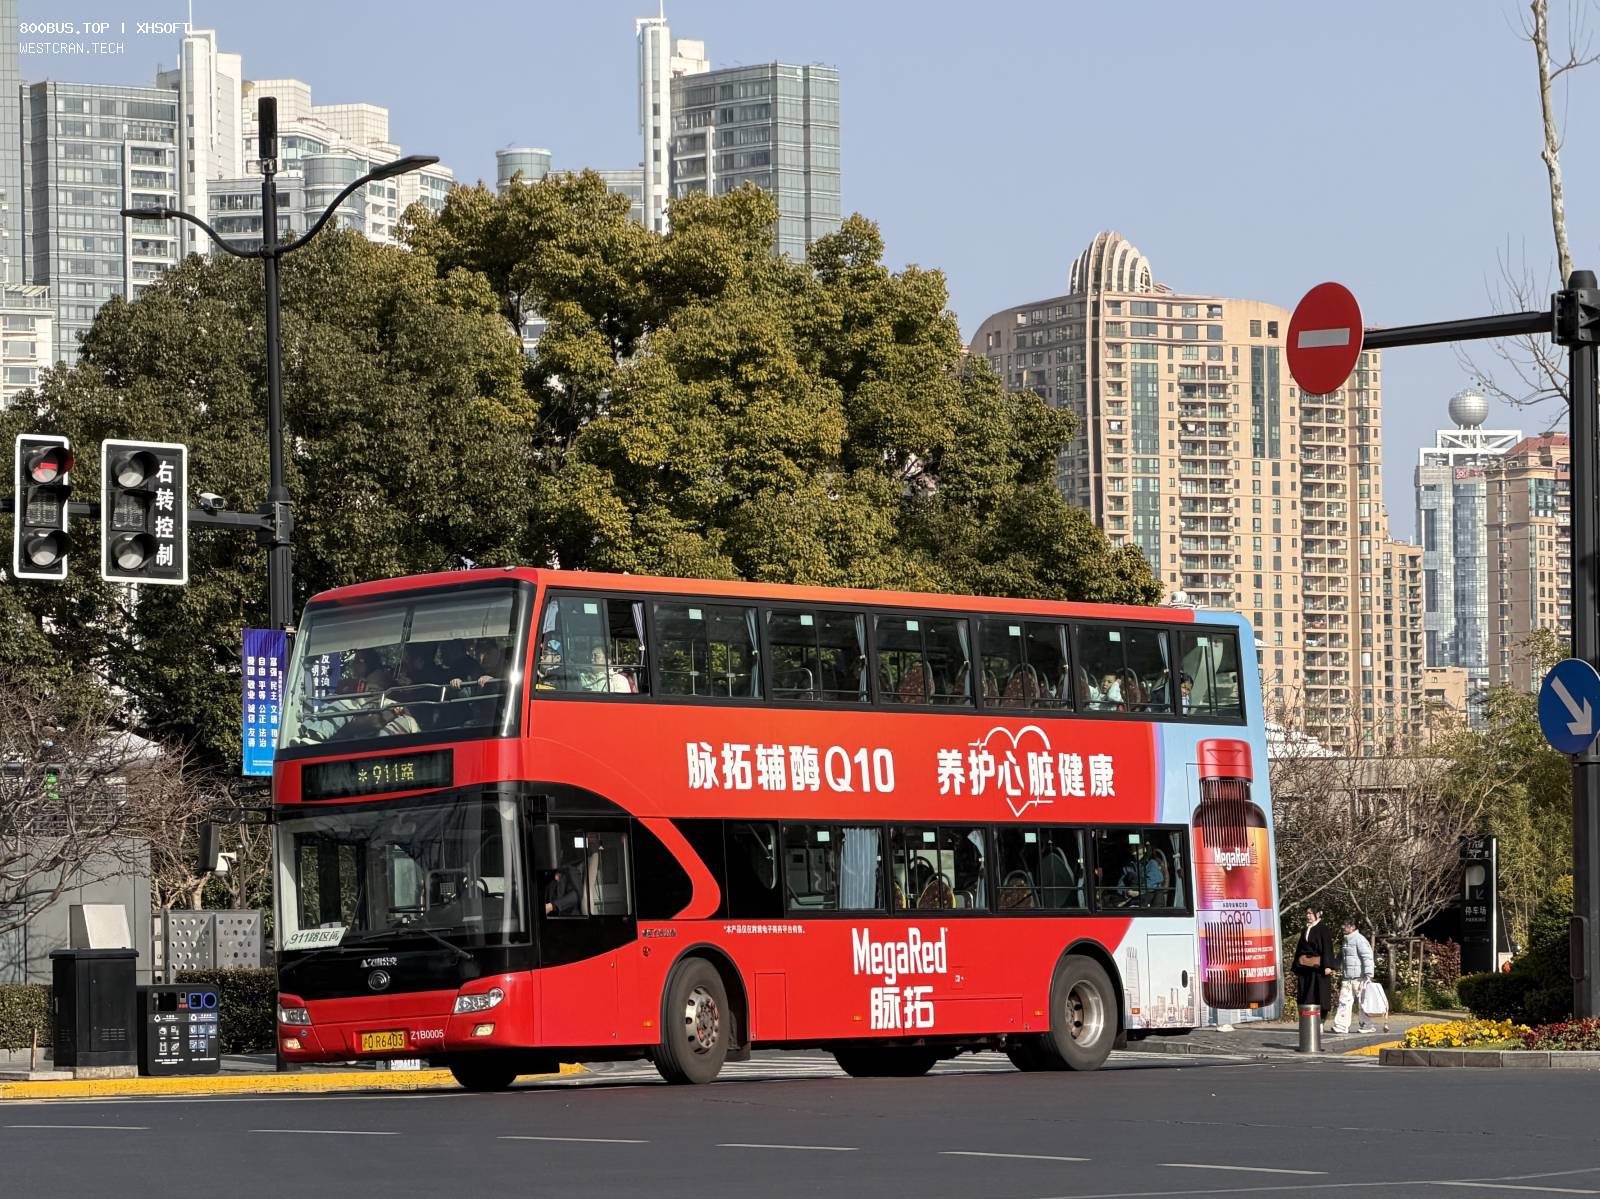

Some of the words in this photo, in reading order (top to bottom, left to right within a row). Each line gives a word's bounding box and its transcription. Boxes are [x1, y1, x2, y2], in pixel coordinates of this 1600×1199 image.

[156, 460, 174, 566] 右转控制
[258, 704, 267, 724] 公正
[686, 742, 895, 793] 脉拓辅酶Q10
[937, 749, 1116, 797] 养护心脏健康
[1214, 846, 1251, 871] MegaRed
[1220, 910, 1252, 925] CoQ10
[1464, 906, 1487, 916] 停车场
[289, 930, 340, 945] 911路区间
[851, 927, 948, 985] MegaRed
[870, 986, 935, 1029] 脉拓
[411, 1029, 444, 1040] Z1B0005
